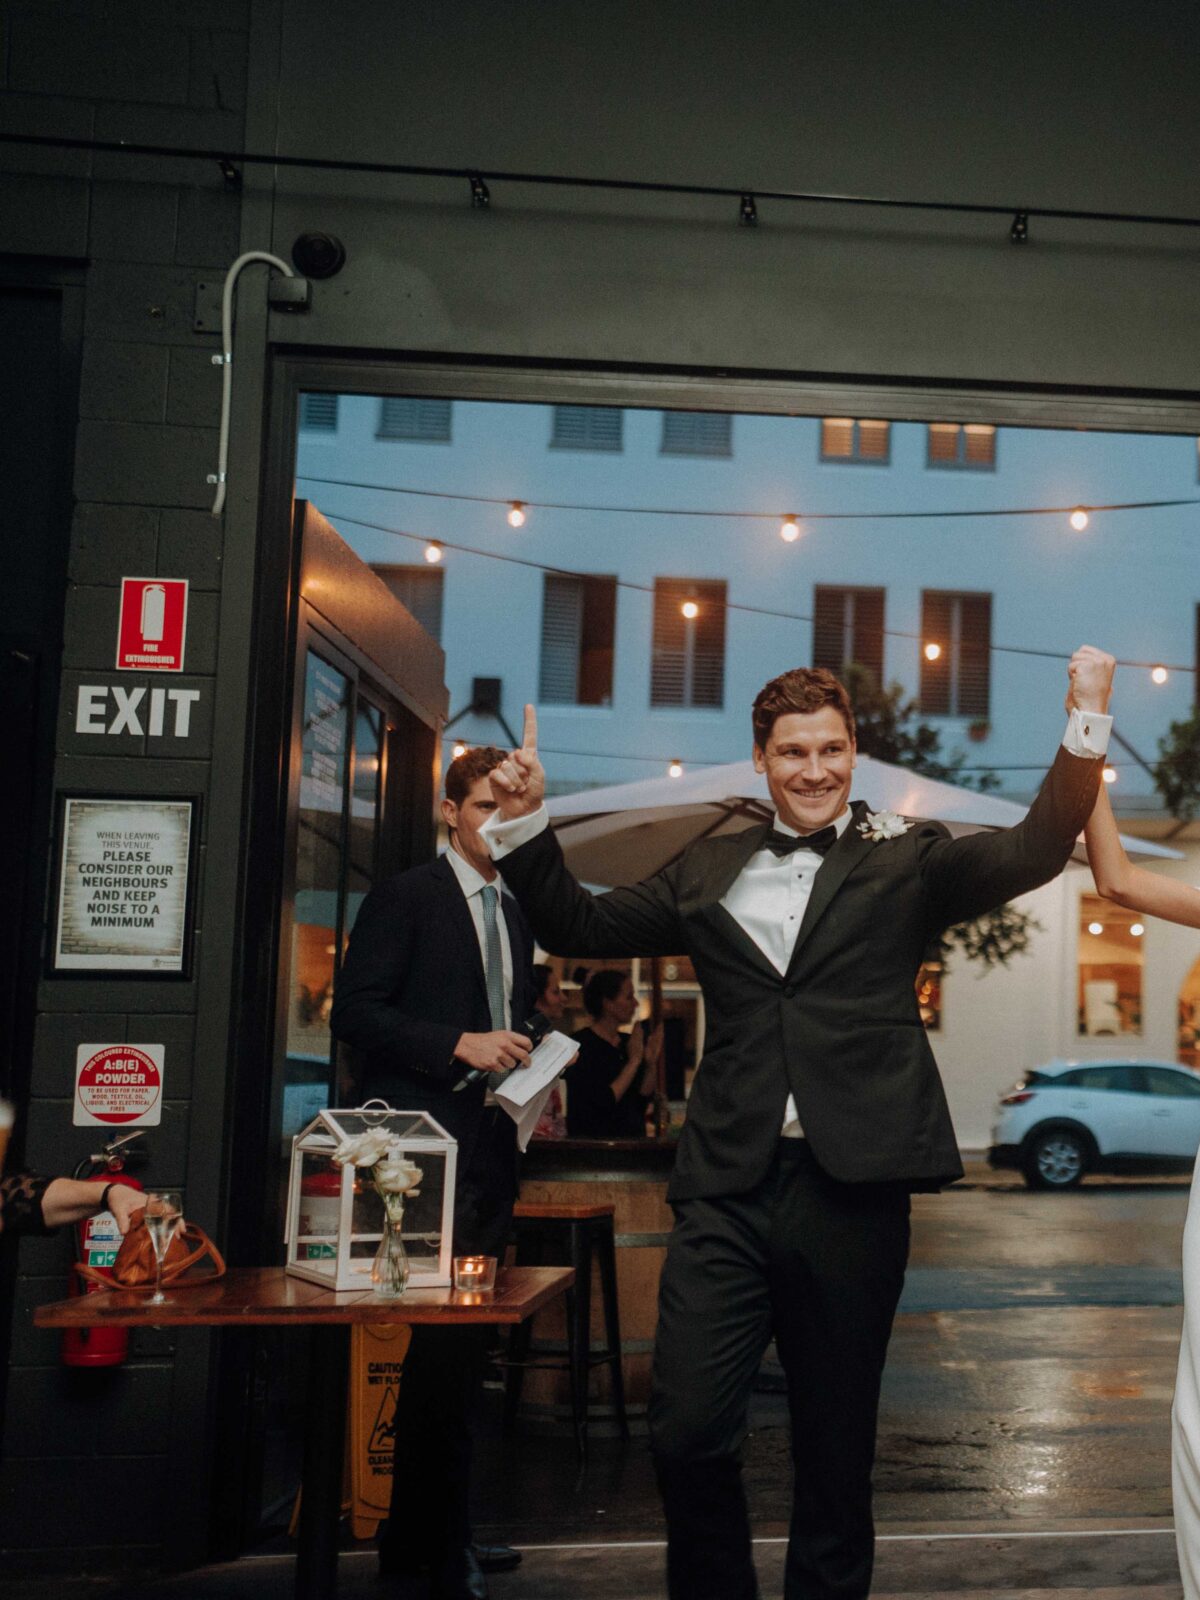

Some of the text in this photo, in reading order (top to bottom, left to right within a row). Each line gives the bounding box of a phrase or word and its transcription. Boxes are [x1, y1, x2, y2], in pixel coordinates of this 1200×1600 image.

[143, 643, 158, 652] FIRE
[125, 654, 175, 664] EXTINGUISHER
[76, 685, 200, 737] EXIT
[97, 832, 160, 840] WHEN LEAVING
[103, 851, 151, 862] PLEASE
[78, 863, 173, 876] CONSIDER OUR
[82, 877, 168, 888] NEIGHBOURS
[92, 890, 156, 901] AND KEEP
[87, 903, 160, 914] NOISE TO A
[91, 917, 154, 928] MINIMUM
[84, 1048, 156, 1072] THIS COLOURED EXTINGUISHER
[103, 1059, 139, 1072] A:B(E)
[95, 1073, 146, 1084] POWDER
[368, 1362, 401, 1374] CAUTIO
[368, 1376, 400, 1385] WET FLO
